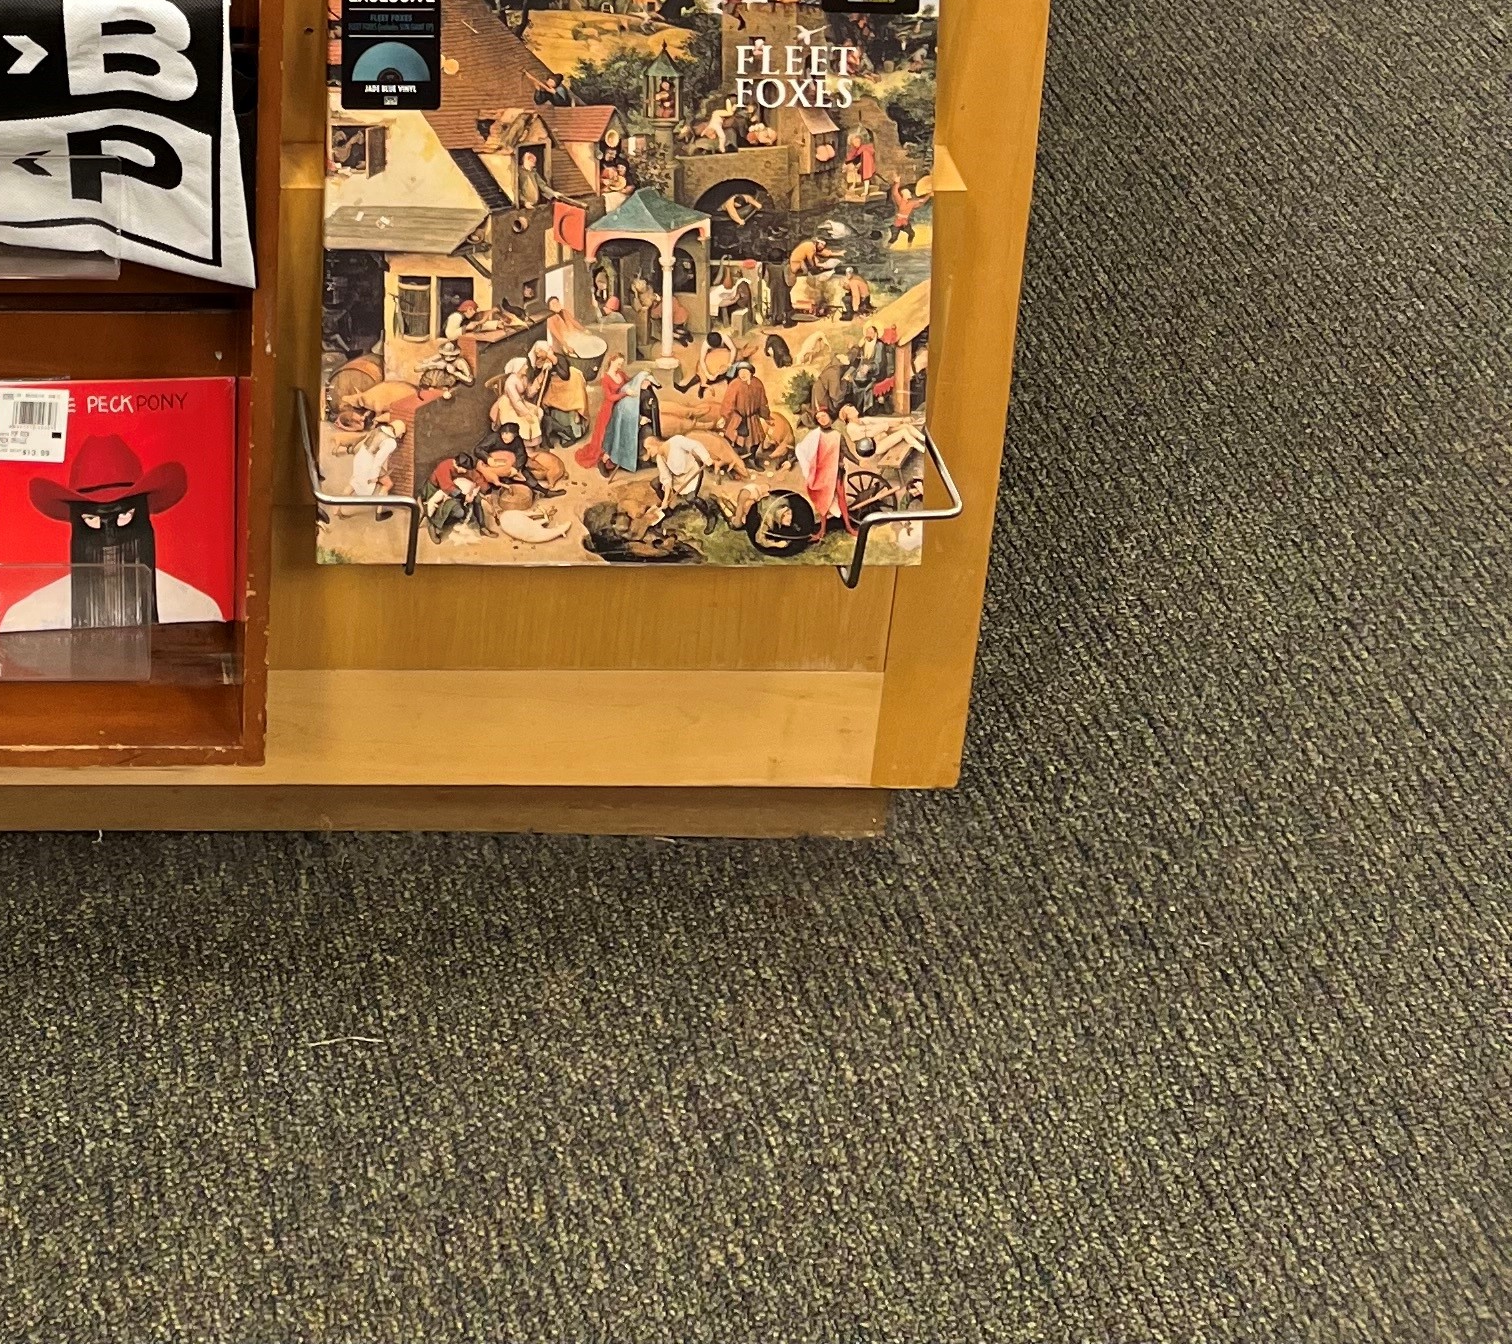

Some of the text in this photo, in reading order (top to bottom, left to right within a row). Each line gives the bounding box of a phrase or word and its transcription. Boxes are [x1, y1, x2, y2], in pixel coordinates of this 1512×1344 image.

[735, 44, 858, 76] FLEET
[735, 77, 854, 109] FOXES
[87, 394, 135, 414] PECK
[135, 391, 188, 412] PONY
